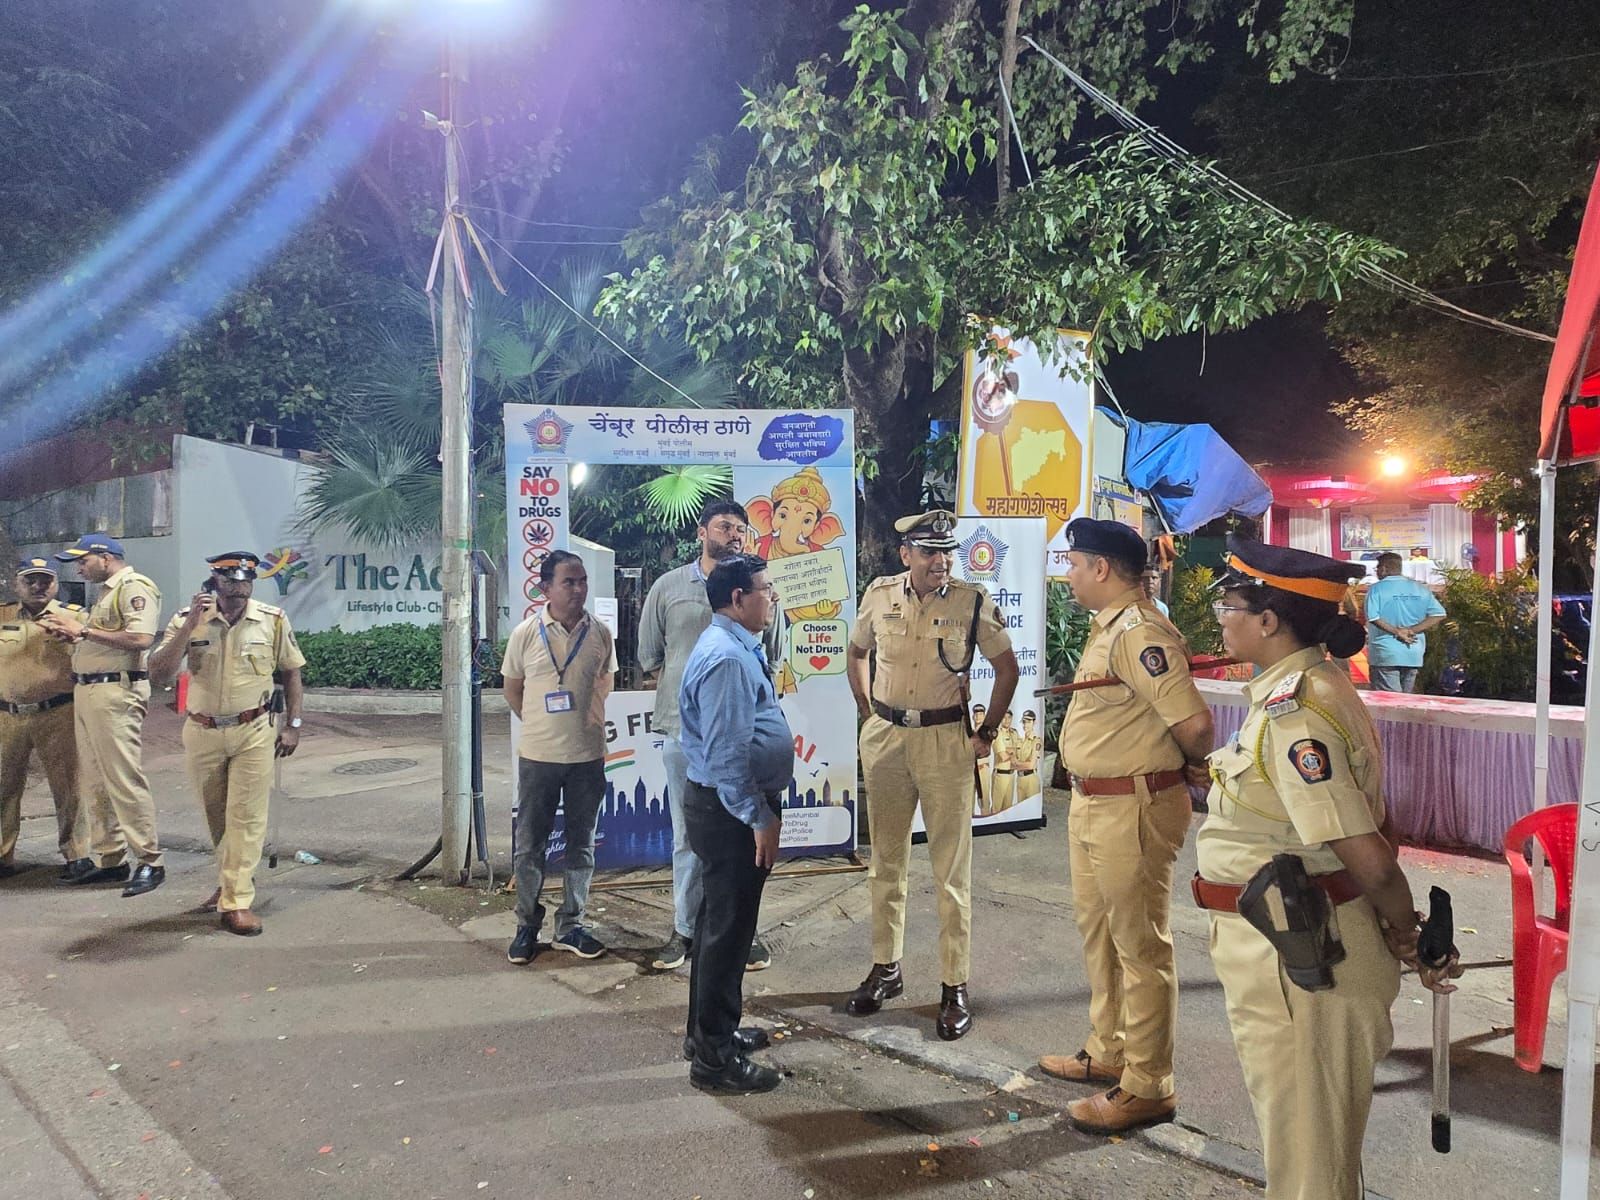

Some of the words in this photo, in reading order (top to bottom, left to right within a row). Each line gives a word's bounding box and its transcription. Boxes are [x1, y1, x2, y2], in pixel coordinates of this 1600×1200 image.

[588, 413, 635, 438] चेंबूर
[645, 414, 709, 435] पोलीस
[714, 416, 751, 435] ठाणे
[781, 421, 816, 431] जनजागृती
[768, 430, 794, 439] आपली
[775, 439, 800, 451] सुरक्षित
[803, 438, 826, 448] भविष्य
[523, 466, 552, 478] SAY
[520, 478, 560, 496] NO
[530, 496, 549, 506] TO
[986, 492, 1071, 521] महागणेशोत्सव
[519, 507, 562, 517] DRUGS
[325, 553, 400, 590] The
[404, 554, 443, 591] Ac
[992, 588, 1022, 607] लीस
[347, 601, 393, 614] Lifestyle
[427, 602, 442, 613] Ch
[1006, 615, 1023, 628] ICE
[803, 624, 837, 632] Choose
[808, 633, 832, 644] Life
[796, 645, 813, 653] Not
[816, 645, 844, 655] Drugs
[1013, 647, 1037, 660] तीस
[969, 668, 994, 679] ELPFU
